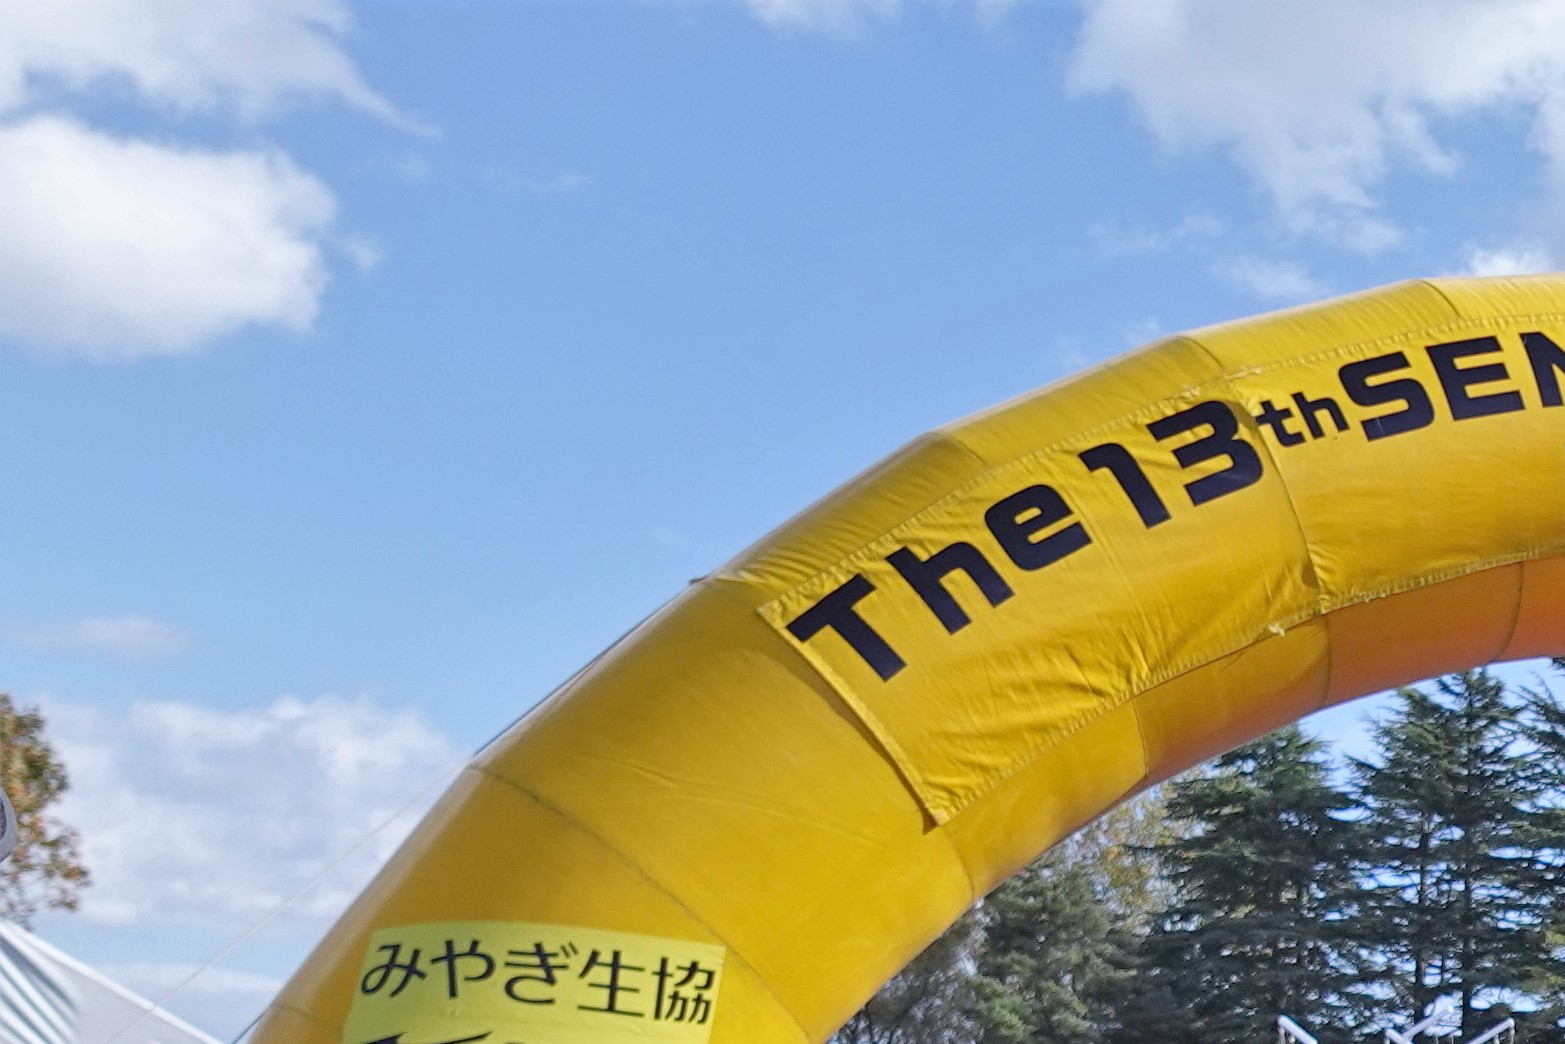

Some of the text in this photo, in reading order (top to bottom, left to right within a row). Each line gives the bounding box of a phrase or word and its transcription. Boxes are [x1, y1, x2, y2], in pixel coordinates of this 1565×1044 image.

[784, 483, 1093, 682] The
[1080, 390, 1350, 529] 13th
[360, 938, 717, 1026] みやぎ生協
